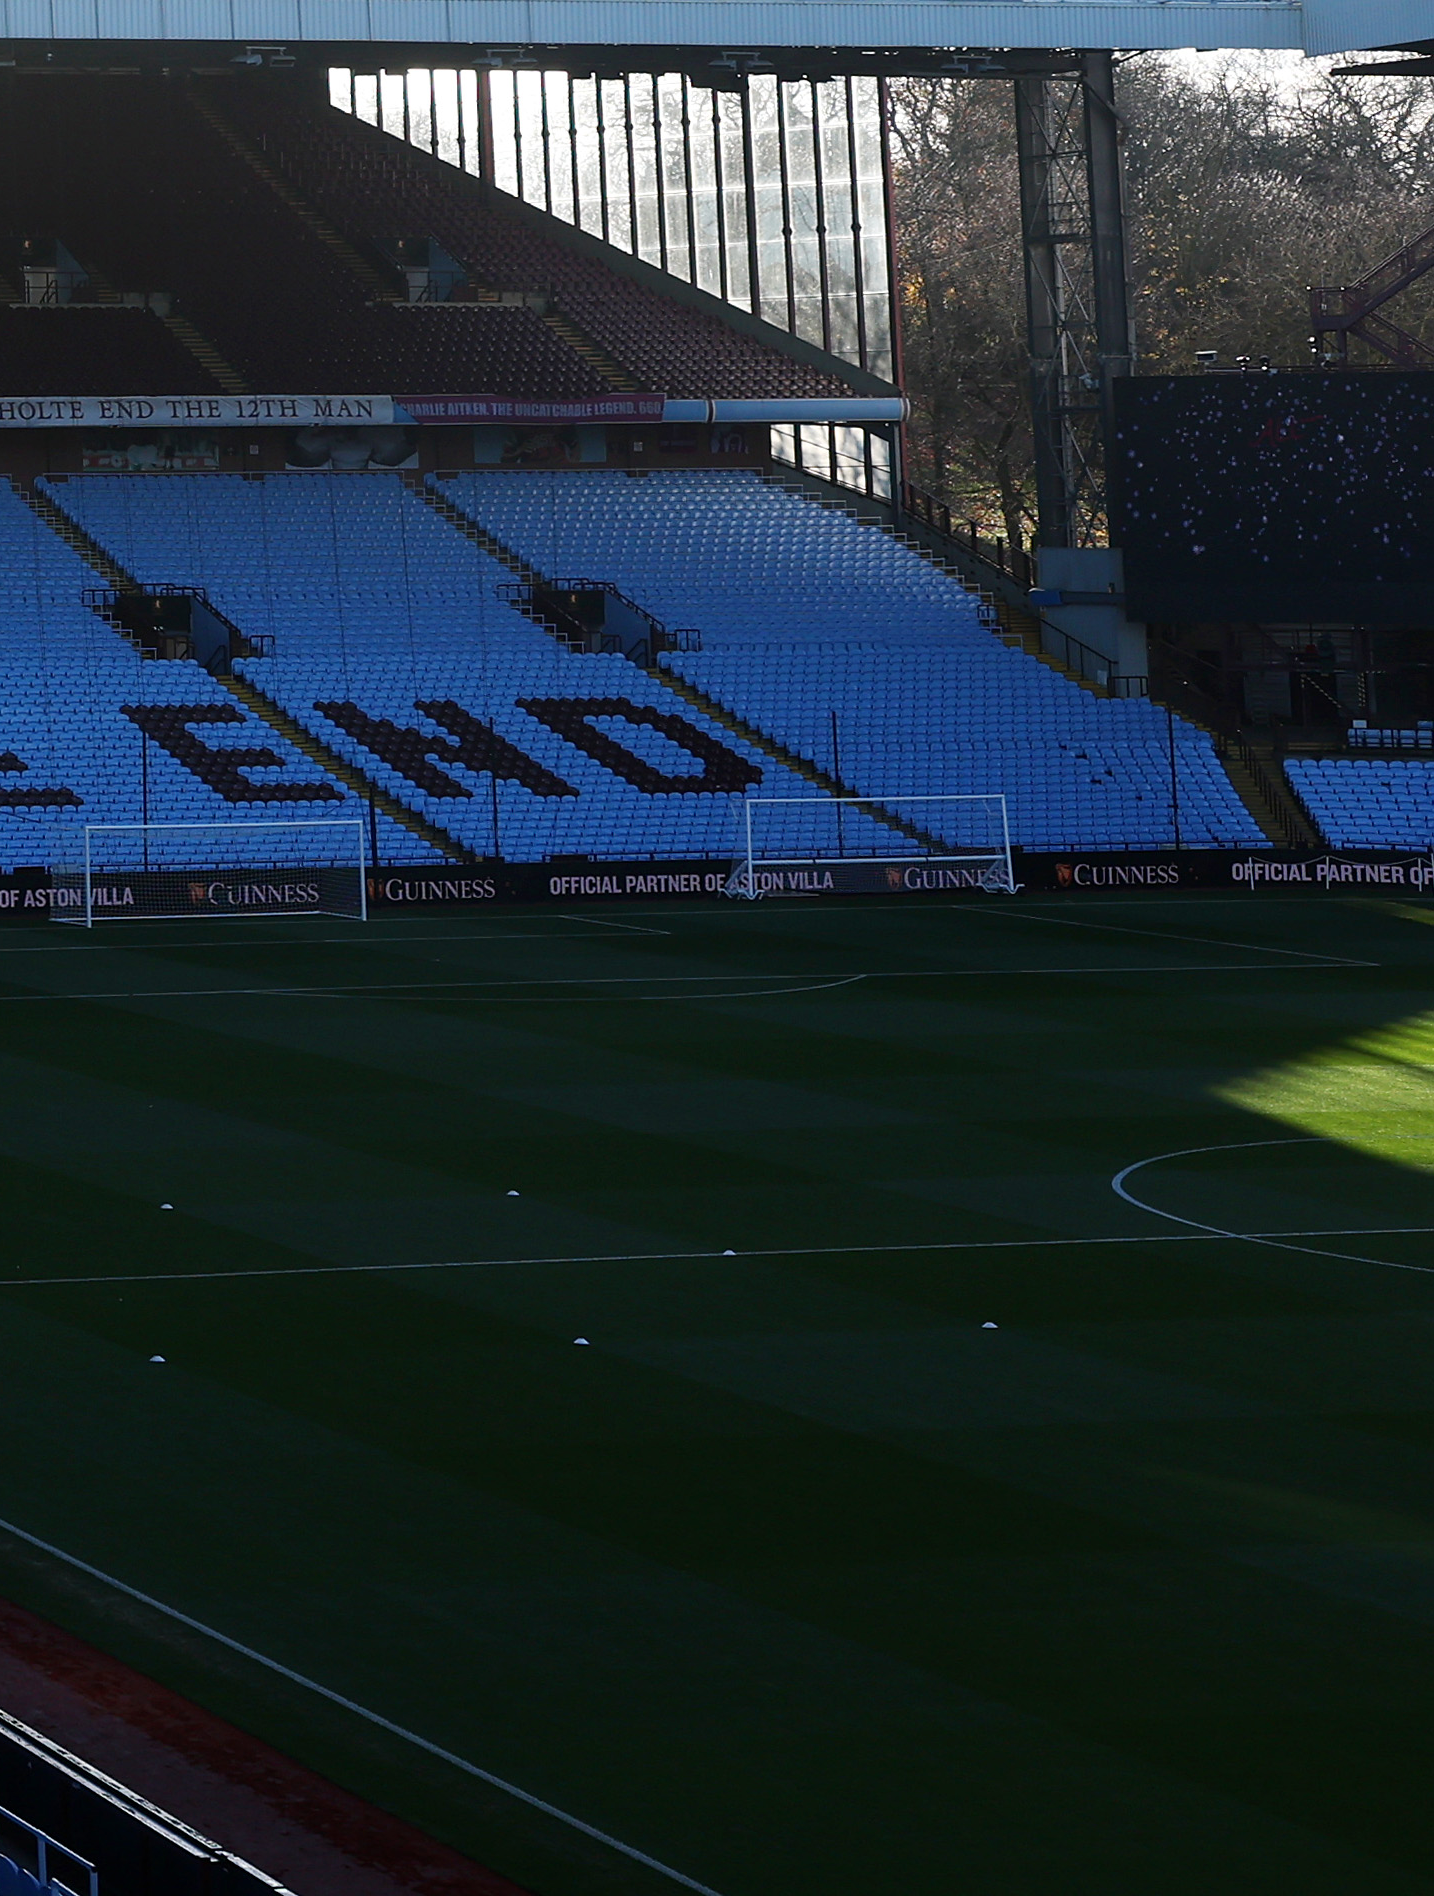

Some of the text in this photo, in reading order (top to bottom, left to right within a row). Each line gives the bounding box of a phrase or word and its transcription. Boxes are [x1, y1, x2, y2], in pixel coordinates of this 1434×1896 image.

[98, 400, 155, 420] END
[166, 400, 222, 419] THE
[235, 399, 298, 419] 12TH
[312, 399, 374, 419] MAN
[492, 403, 513, 416] THE
[514, 403, 593, 417] UNCATCHABLE
[120, 697, 763, 803] END
[549, 875, 622, 896] OFFICIAL
[626, 874, 702, 894] PARTNER
[788, 870, 834, 890] VILLA
[1232, 862, 1313, 882] OFFICIAL
[1316, 863, 1406, 884] PARTNER
[24, 887, 83, 908] ASTON
[384, 877, 496, 902] GUINNESS
